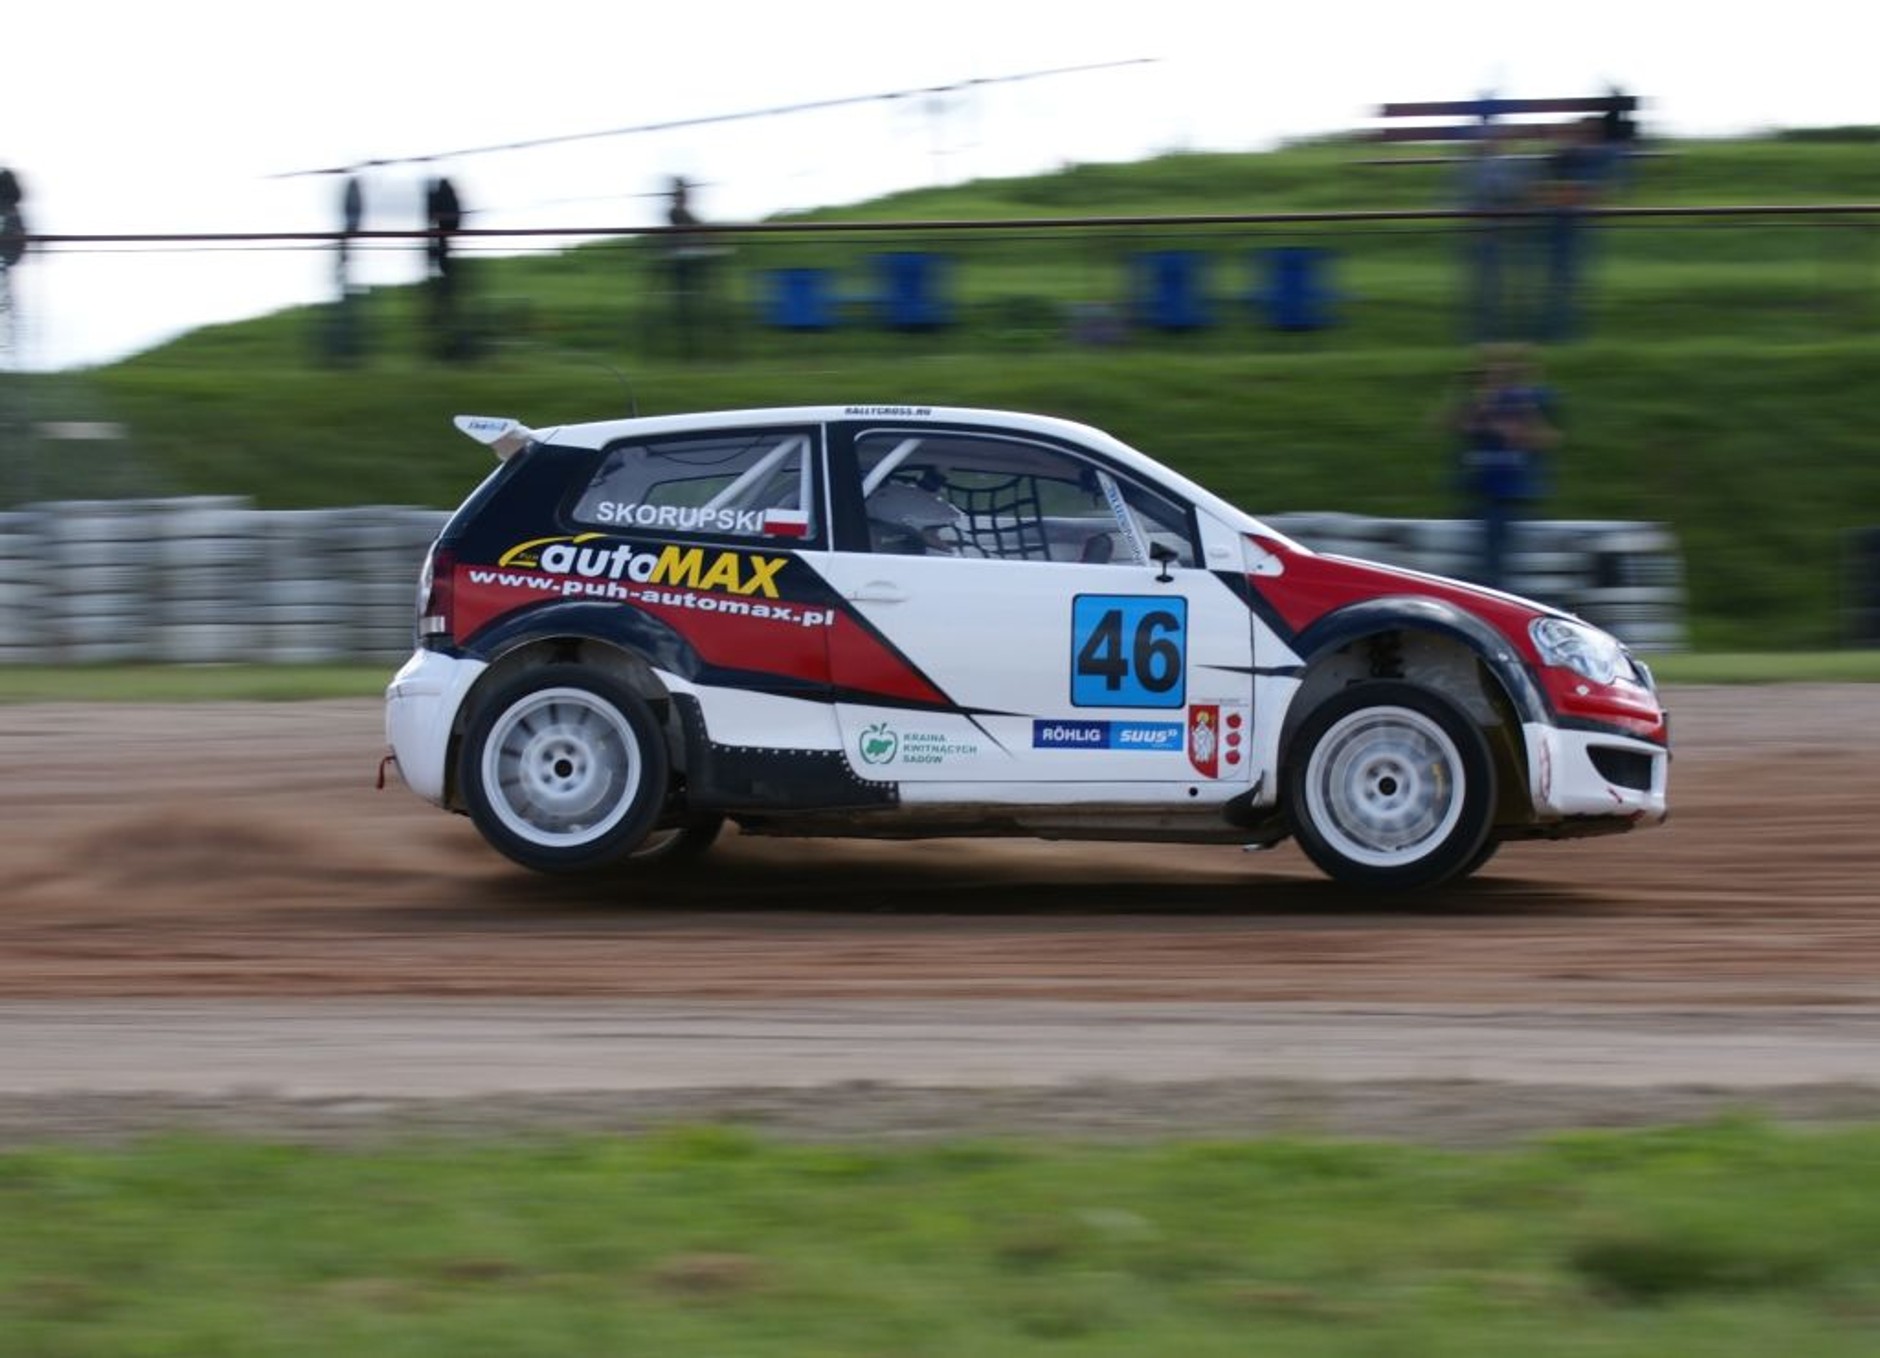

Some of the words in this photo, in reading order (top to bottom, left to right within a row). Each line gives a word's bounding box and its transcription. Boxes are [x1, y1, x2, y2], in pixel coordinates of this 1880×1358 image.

[597, 501, 763, 532] SKORUPSKI
[469, 569, 835, 627] www.puh-automax.pl
[1078, 609, 1182, 694] 46
[903, 733, 946, 742] KRAINA
[1042, 725, 1101, 742] RÖHLIG
[1119, 729, 1168, 743] SUUS
[903, 754, 943, 764] SADÓW
